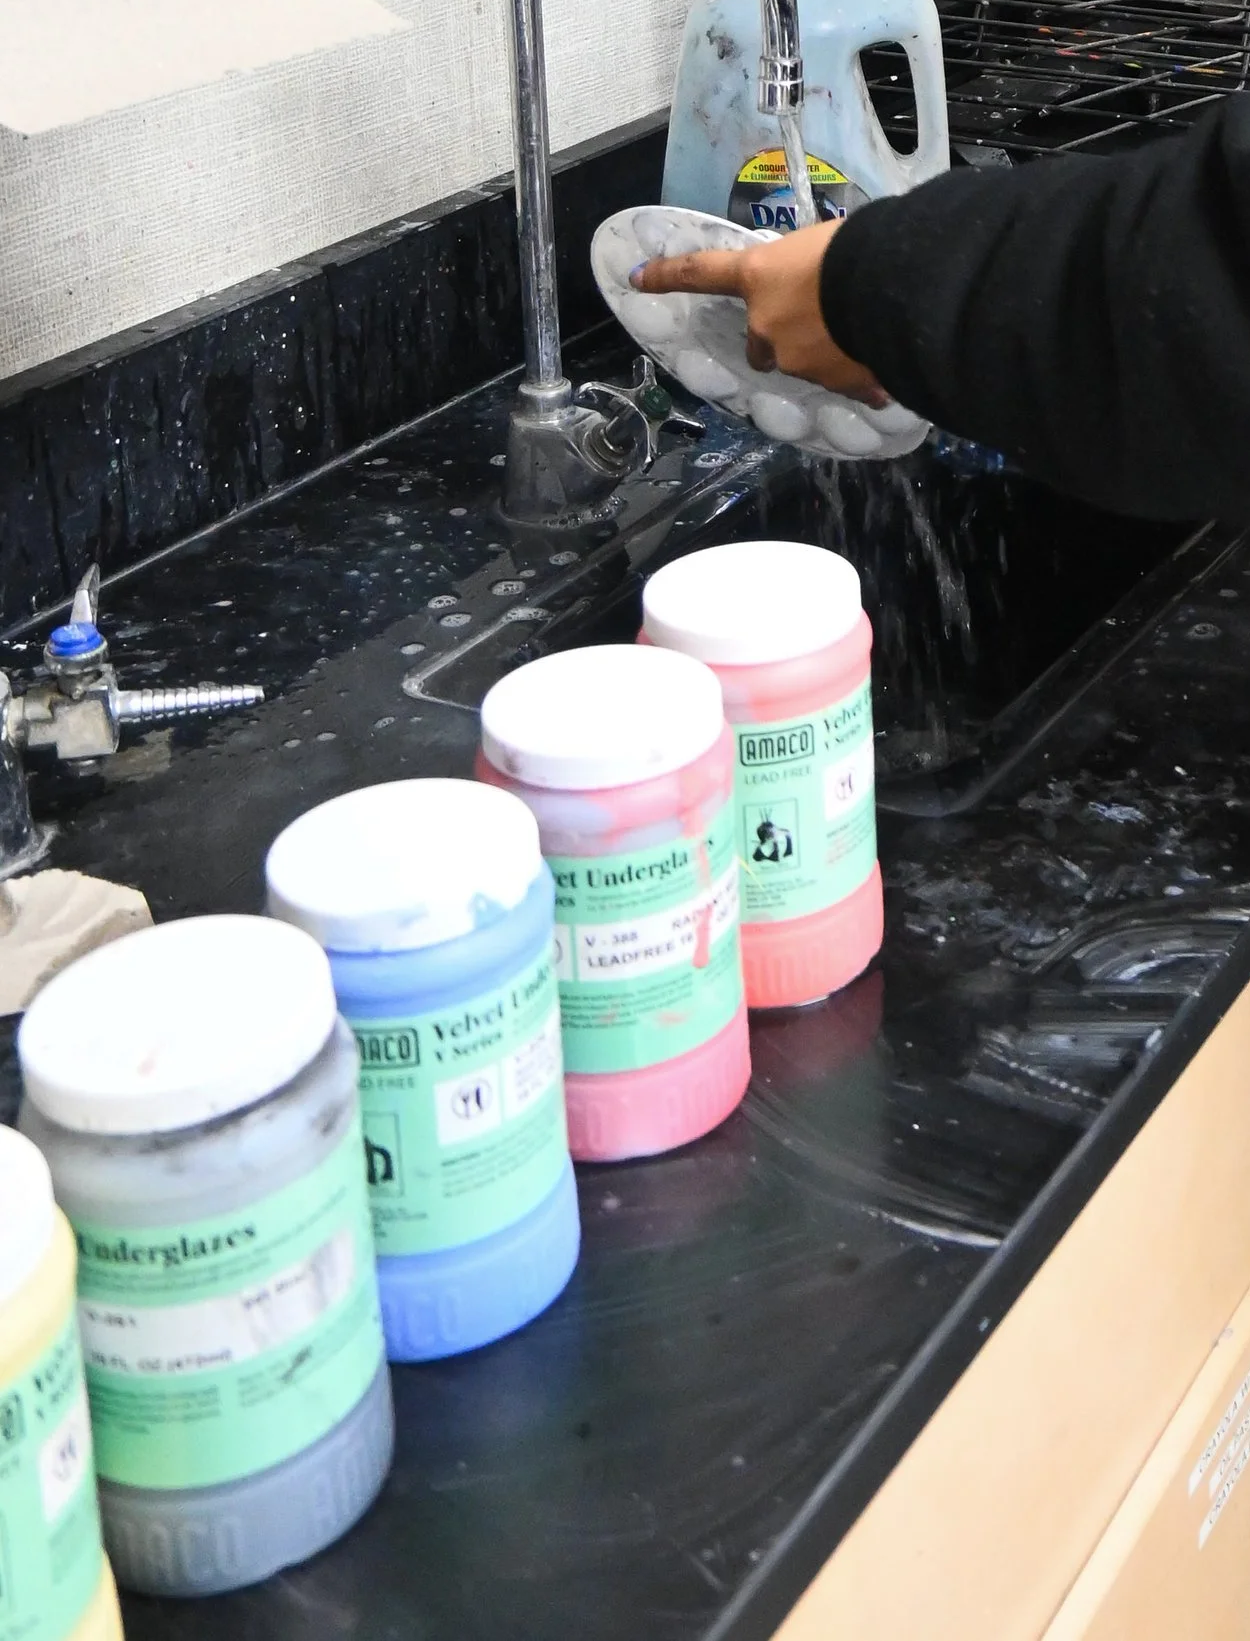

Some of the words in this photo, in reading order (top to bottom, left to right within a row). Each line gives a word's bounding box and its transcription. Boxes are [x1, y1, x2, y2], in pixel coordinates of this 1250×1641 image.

[746, 730, 809, 761] AMACO
[744, 770, 780, 786] LEAD
[783, 764, 812, 781] FREE
[586, 837, 714, 890] Underglas
[588, 940, 675, 969] LEADFREE
[356, 1034, 411, 1062] ACO
[432, 1000, 504, 1041] Velvet
